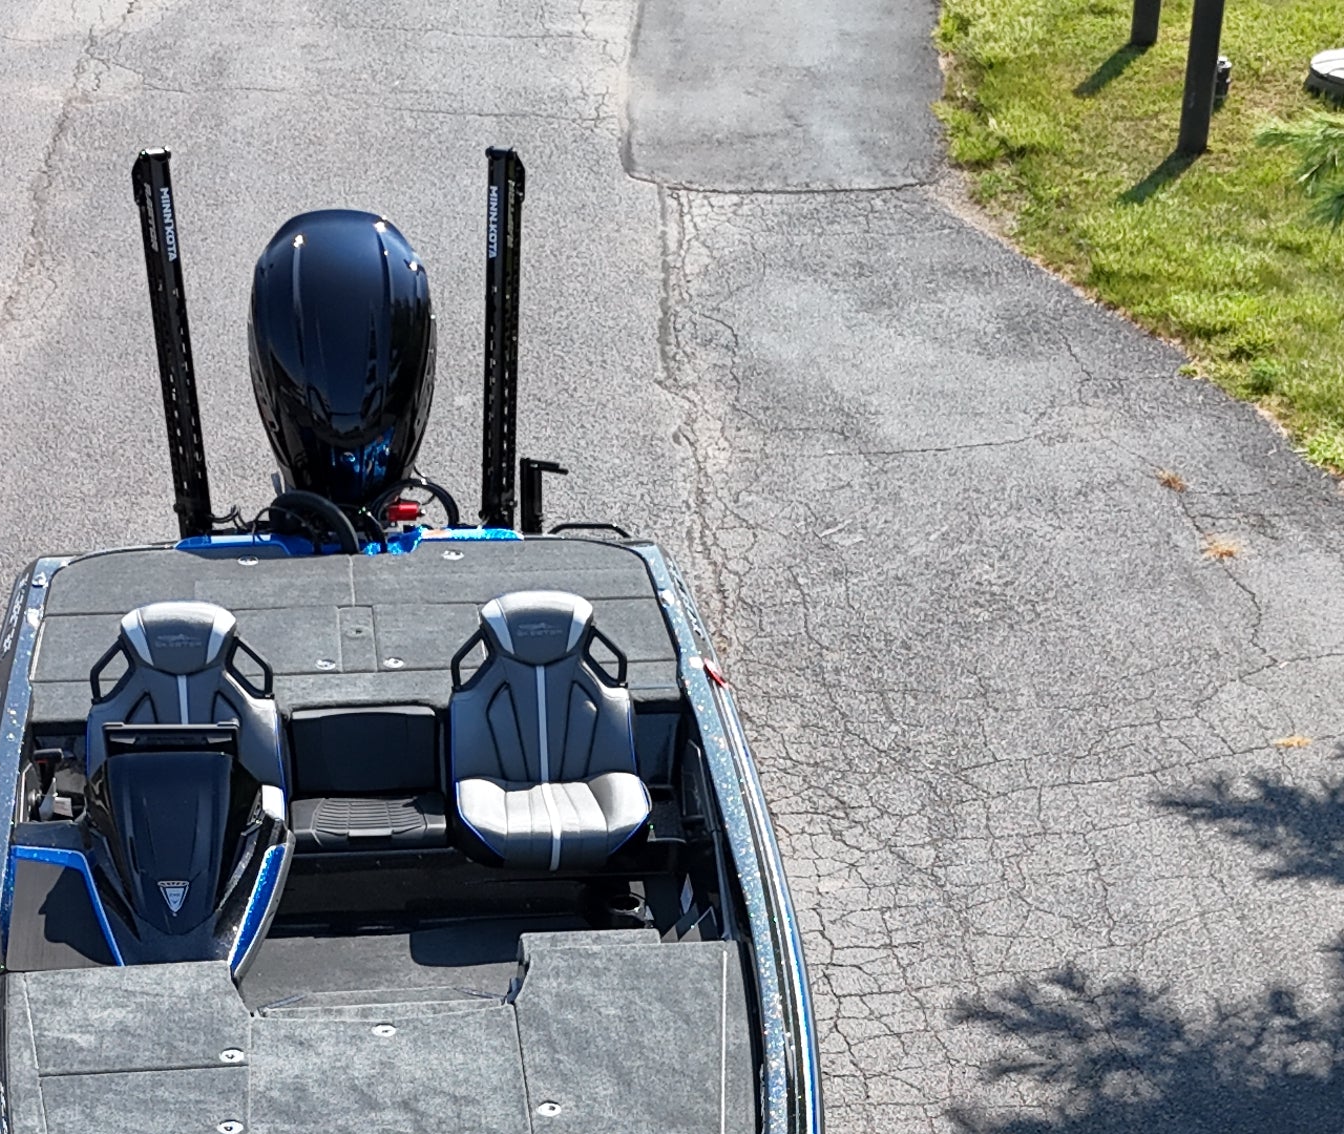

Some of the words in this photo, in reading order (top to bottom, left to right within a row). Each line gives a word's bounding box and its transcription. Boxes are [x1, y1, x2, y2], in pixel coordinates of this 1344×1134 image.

[160, 187, 174, 224] MINN
[489, 185, 498, 222] MINN
[164, 225, 177, 262] KOTA
[488, 225, 498, 259] KOTA
